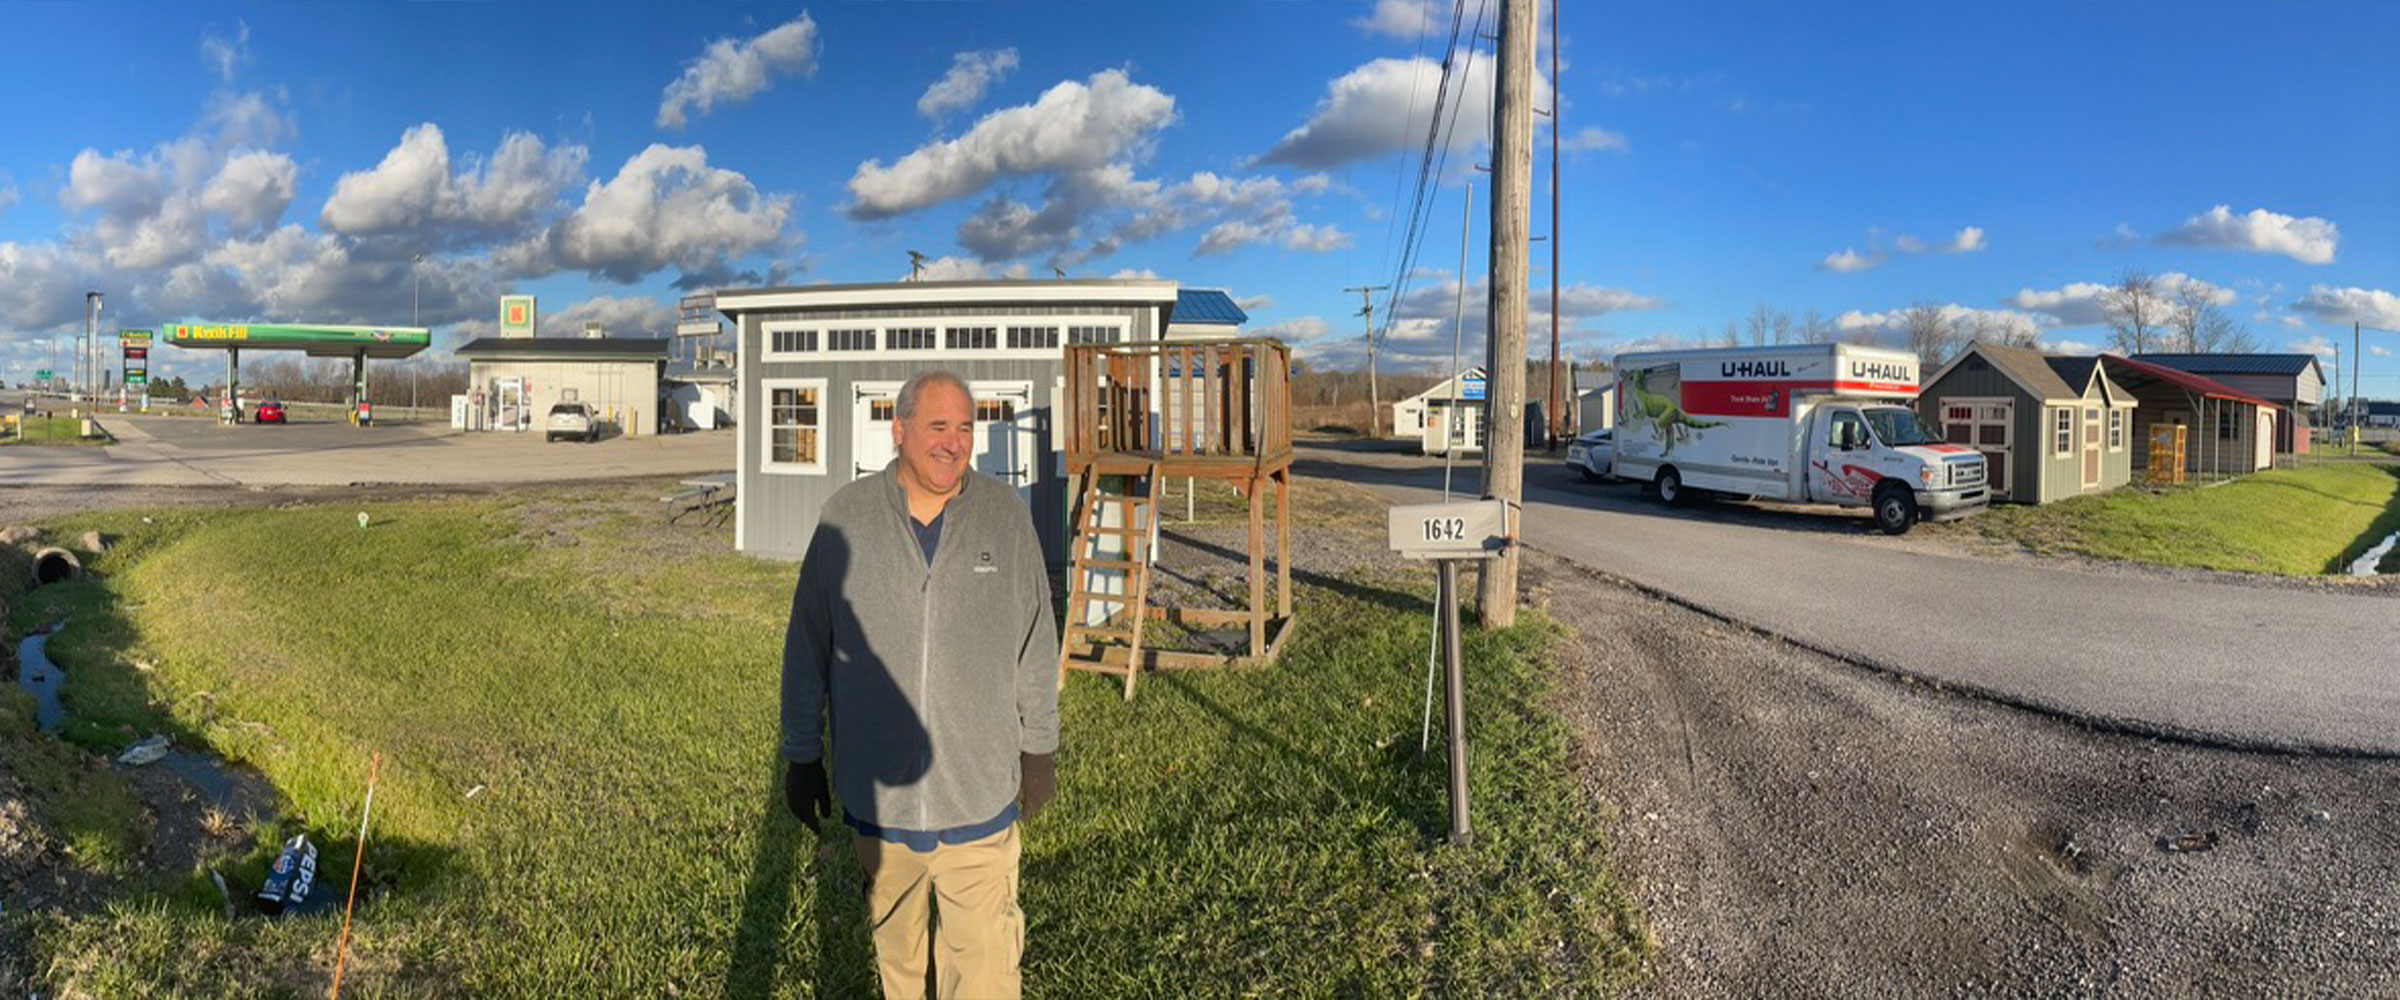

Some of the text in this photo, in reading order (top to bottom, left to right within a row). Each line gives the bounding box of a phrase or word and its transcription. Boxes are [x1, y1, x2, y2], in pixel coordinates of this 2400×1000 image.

[1722, 361, 1791, 377] U-HAUL
[1852, 361, 1911, 381] U-HAUL
[1424, 518, 1464, 540] 1642
[290, 841, 318, 903] PEPSI
